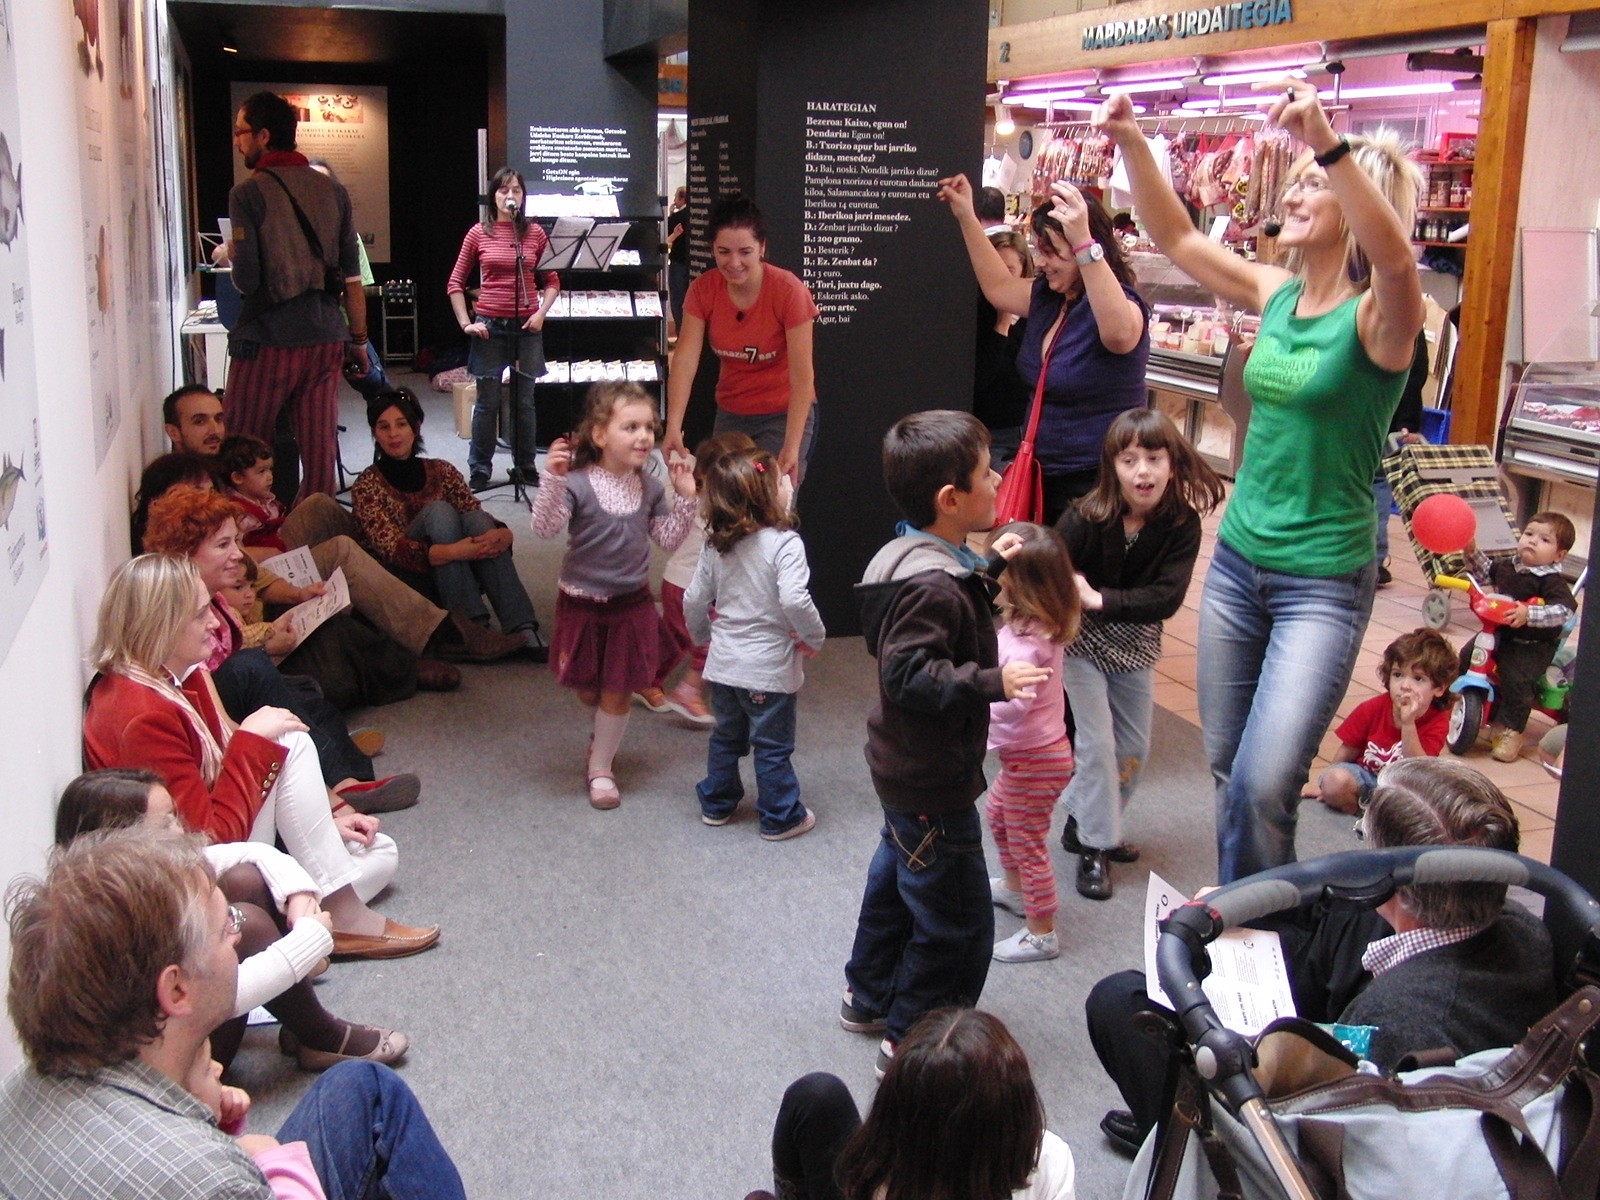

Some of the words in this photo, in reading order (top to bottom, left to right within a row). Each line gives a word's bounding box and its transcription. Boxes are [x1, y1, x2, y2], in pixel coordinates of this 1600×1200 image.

[1081, 14, 1170, 50] MARDARAS
[1173, 0, 1292, 38] URDAITEGIA
[807, 102, 877, 113] HARATEGIAN
[806, 117, 843, 126] Bezeroa:
[844, 118, 871, 128] Kaixo,
[873, 120, 892, 130] egun
[894, 120, 907, 128] on!
[806, 129, 850, 138] Dendaria:
[852, 130, 871, 141] Egun
[819, 142, 852, 150] Txorizo
[853, 144, 873, 153] apur
[874, 143, 887, 151] bat
[888, 144, 916, 154] jarriko
[805, 153, 835, 162] didazu,
[837, 154, 875, 162] mesedez?
[820, 165, 834, 173] Bai,
[836, 166, 858, 174] noski.
[860, 166, 889, 175] Nondik
[890, 167, 915, 177] jarriko
[916, 167, 938, 176] dizut?
[805, 176, 842, 187] Pamplona
[880, 179, 907, 187] eurotan
[909, 178, 938, 188] daukazu
[804, 188, 826, 197] kiloa,
[827, 189, 879, 198] Salamancakoa
[804, 199, 836, 208] Iberikoa
[818, 211, 853, 220] Iberikoa
[854, 212, 873, 222] jarri
[874, 213, 911, 221] mesedez.
[847, 224, 872, 233] jarriko
[874, 224, 893, 232] dizut
[816, 281, 836, 290] Tori,
[837, 281, 859, 290] juxtu
[860, 281, 882, 291] dago.
[817, 315, 837, 324] Agur,
[744, 346, 758, 364] 7
